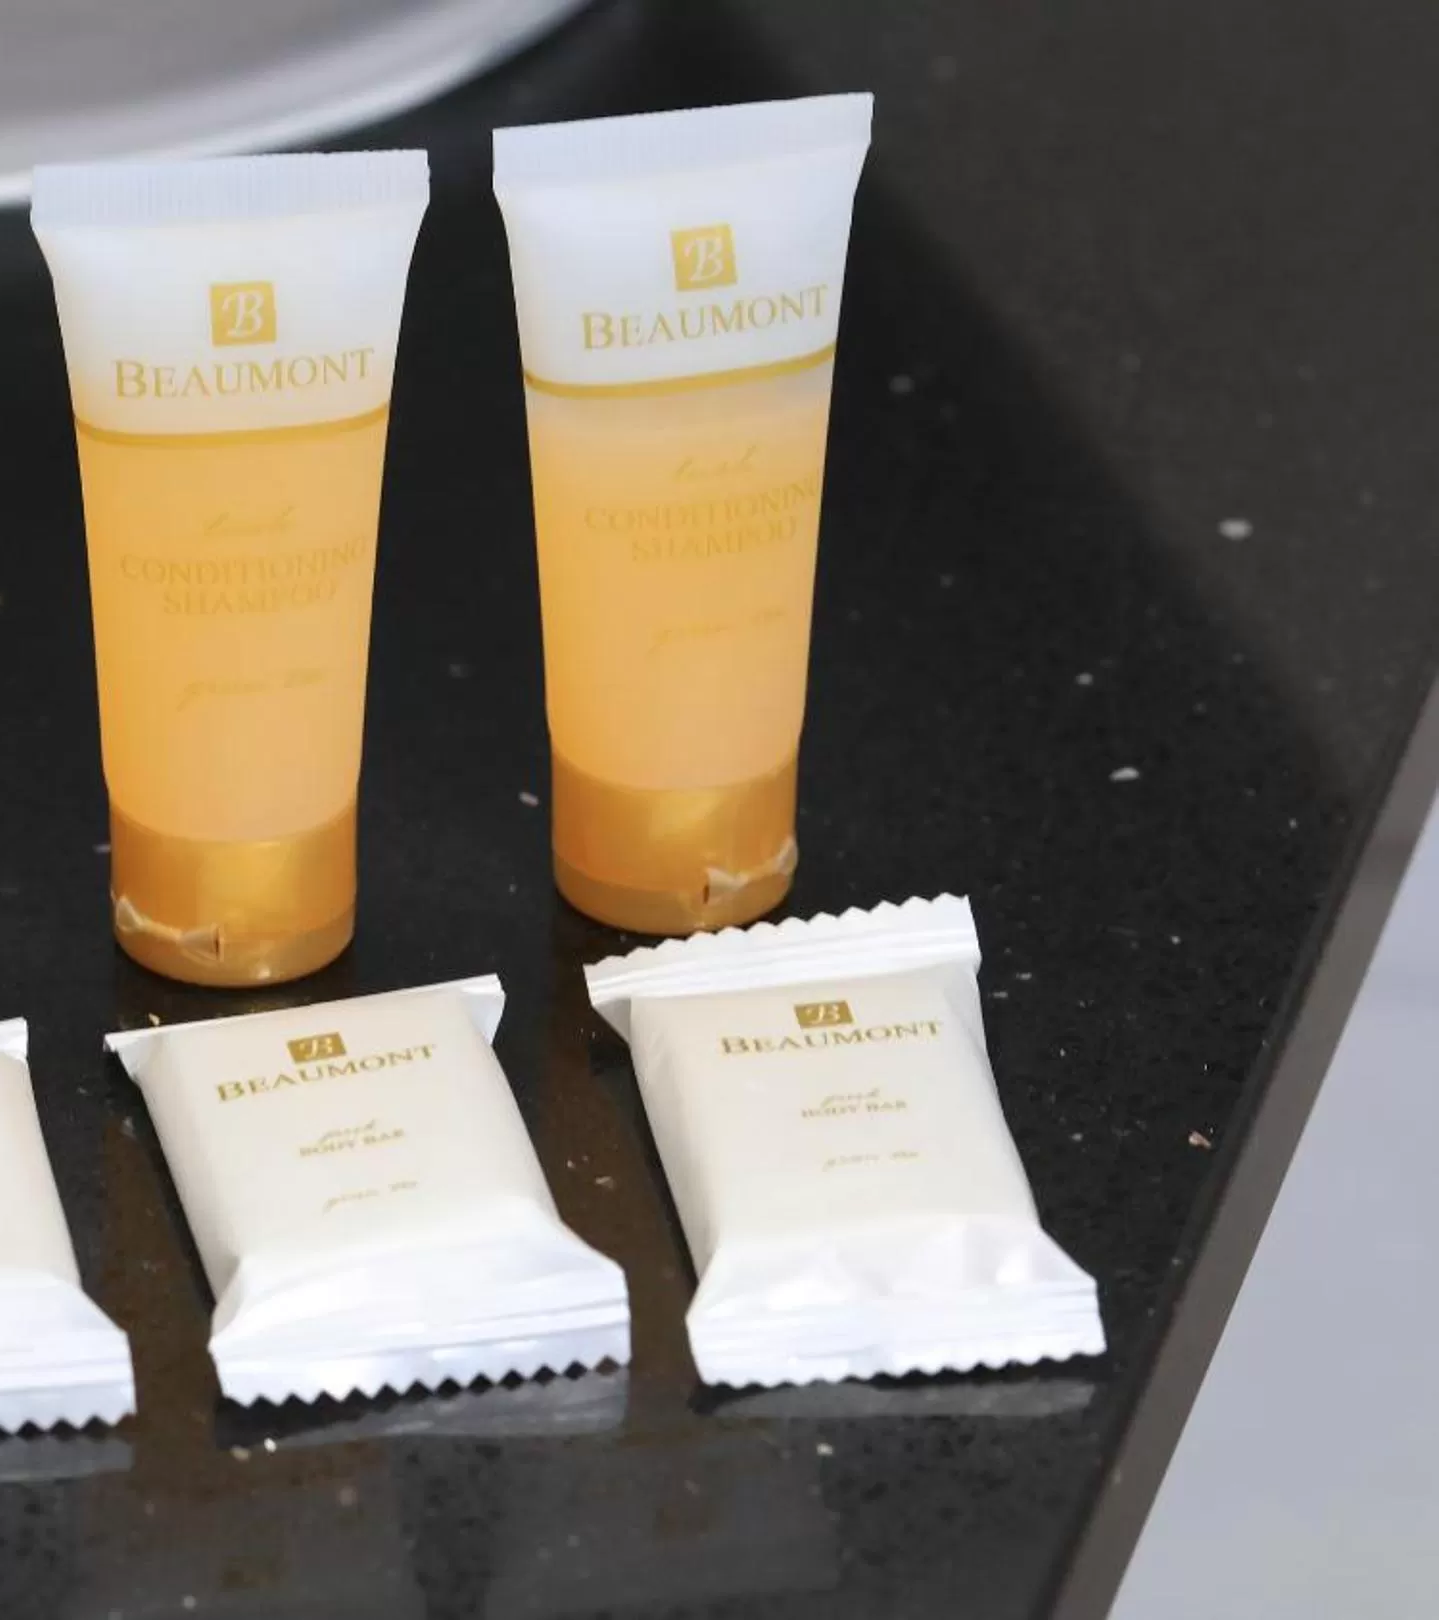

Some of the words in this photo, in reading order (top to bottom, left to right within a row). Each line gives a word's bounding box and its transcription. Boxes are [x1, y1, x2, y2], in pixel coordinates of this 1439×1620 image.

[581, 284, 828, 351] BEAUMONT
[114, 347, 375, 399] BEAUMONT
[721, 1020, 942, 1055] BEAUMONT
[216, 1044, 436, 1102] BEAUMONT
